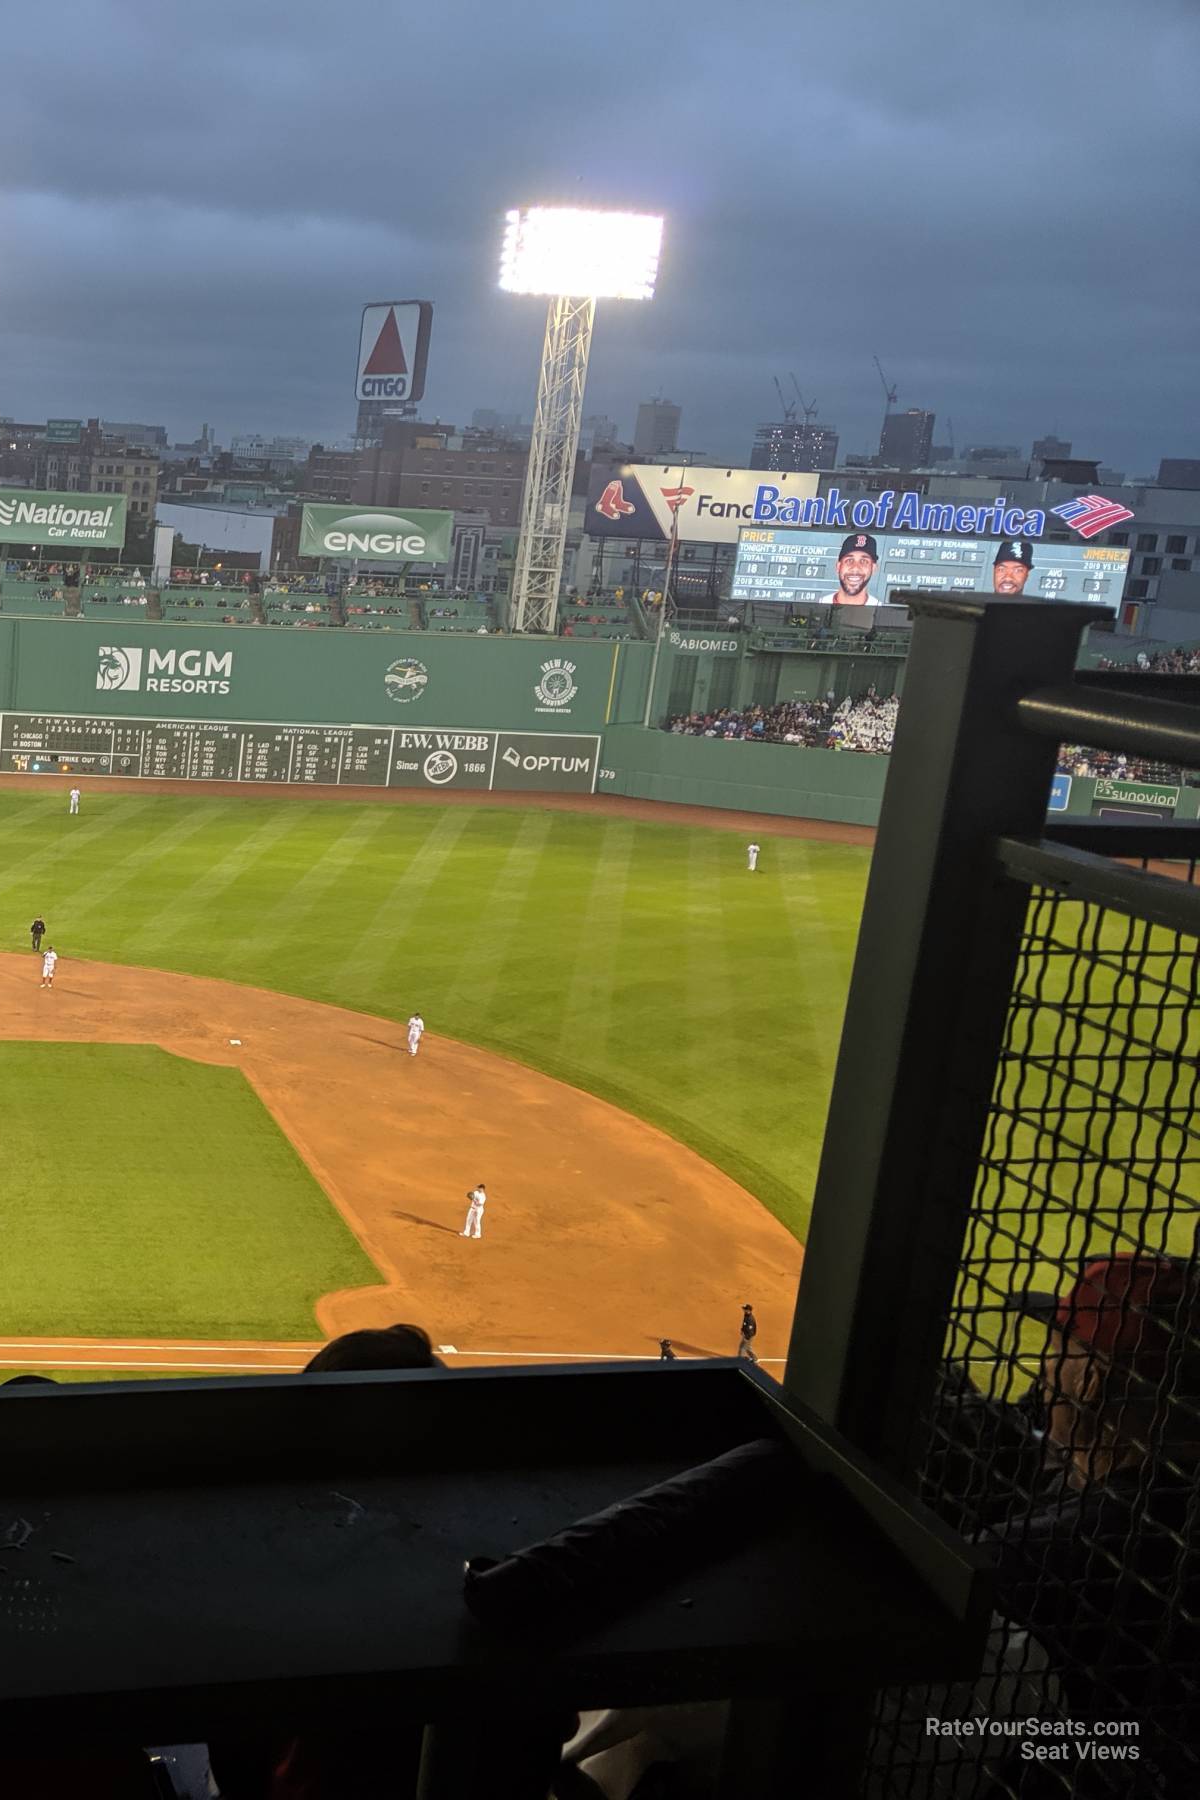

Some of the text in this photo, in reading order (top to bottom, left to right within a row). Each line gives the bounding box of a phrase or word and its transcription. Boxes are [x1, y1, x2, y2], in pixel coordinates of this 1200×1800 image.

[362, 378, 406, 396] CITGO
[753, 482, 1045, 536] Bank of America
[48, 528, 106, 538] Car Rental
[742, 531, 775, 542] PRICE
[740, 544, 827, 555] TONIGHT'S PITCH COUNT
[898, 538, 920, 546] MOUND
[944, 541, 978, 549] REMAINING
[743, 554, 764, 562] TOTAL
[771, 556, 796, 564] STRIKES
[889, 548, 906, 556] CWS
[920, 550, 926, 558] 5
[940, 552, 957, 560] BOS
[747, 564, 818, 576] 18 12 67
[886, 574, 974, 586] BALLS STRIKES OUTS
[1041, 578, 1100, 590] .227 3
[1088, 593, 1100, 601] RBI
[680, 640, 738, 651] ABIOMED
[148, 648, 232, 677] MGM
[540, 658, 576, 674] IBEW 103
[146, 678, 230, 694] RESORTS
[30, 718, 76, 726] FENWAY
[400, 734, 488, 750] F.W. WEBB
[14, 760, 28, 770] 74
[396, 760, 486, 772] Since 1866
[523, 756, 590, 772] OPTUM
[599, 769, 616, 778] 379
[1112, 790, 1176, 806] sunovion
